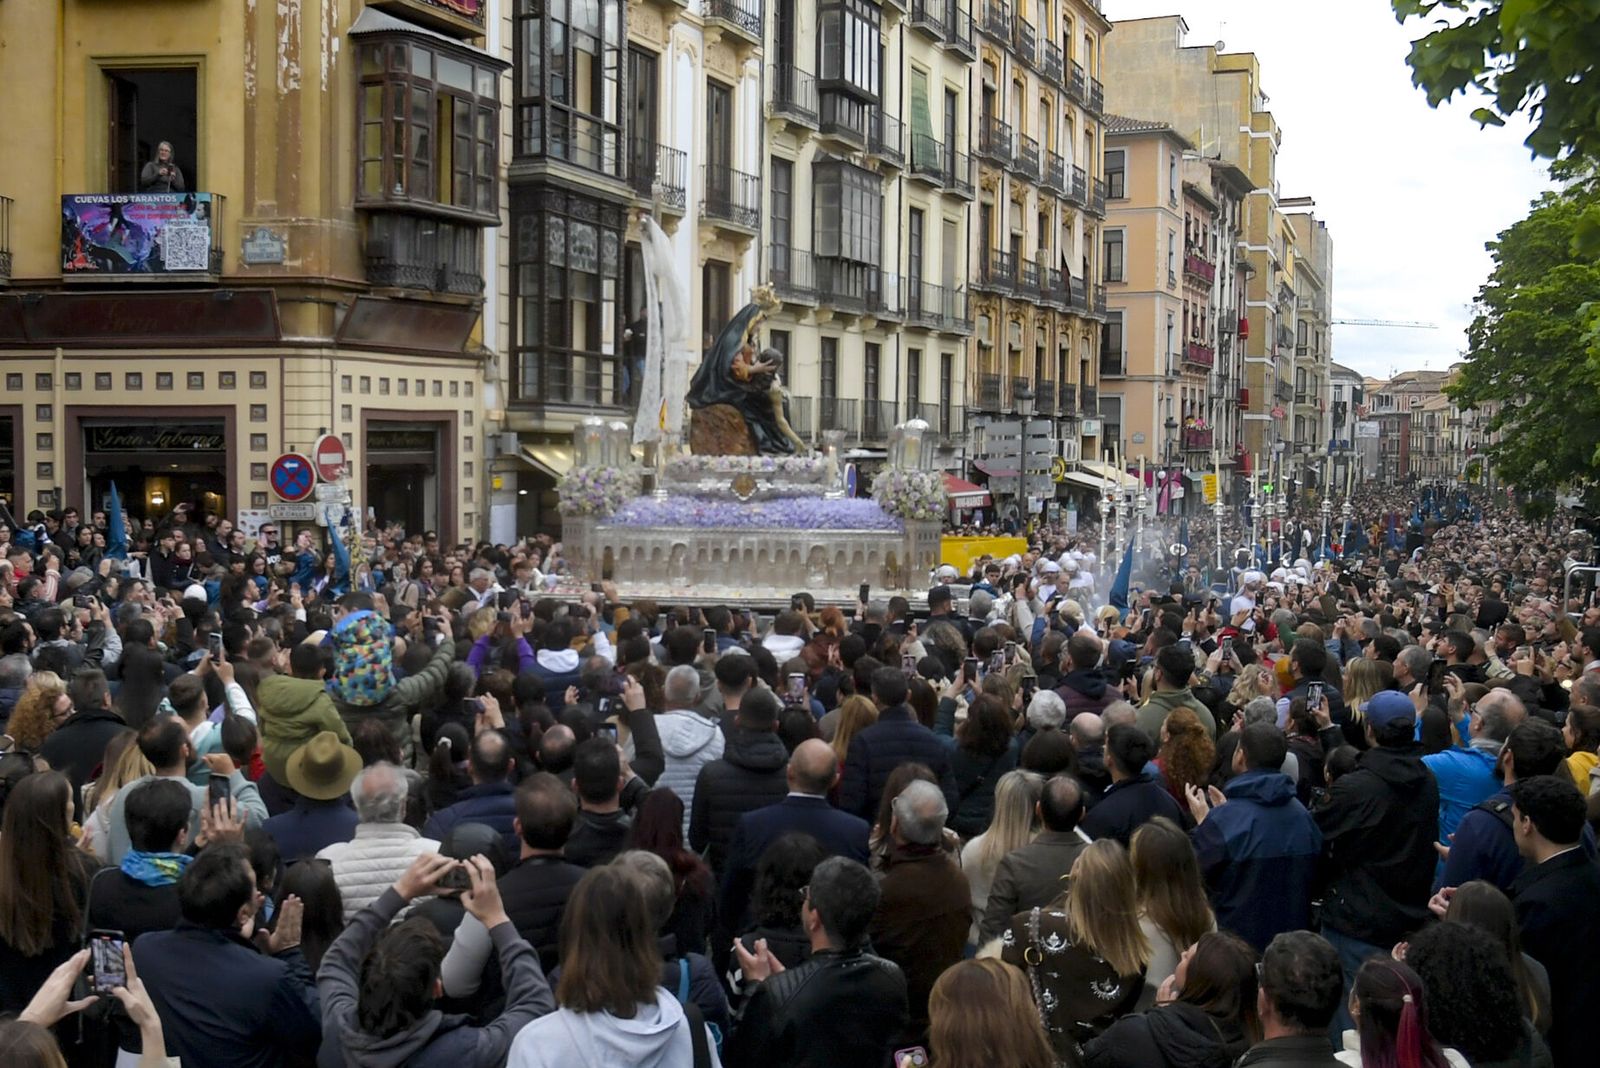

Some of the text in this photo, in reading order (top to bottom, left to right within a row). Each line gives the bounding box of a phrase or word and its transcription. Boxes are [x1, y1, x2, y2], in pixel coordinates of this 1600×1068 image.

[75, 194, 177, 204] CUEVAS LOS TARANTOS
[98, 428, 222, 448] Gran Taberna
